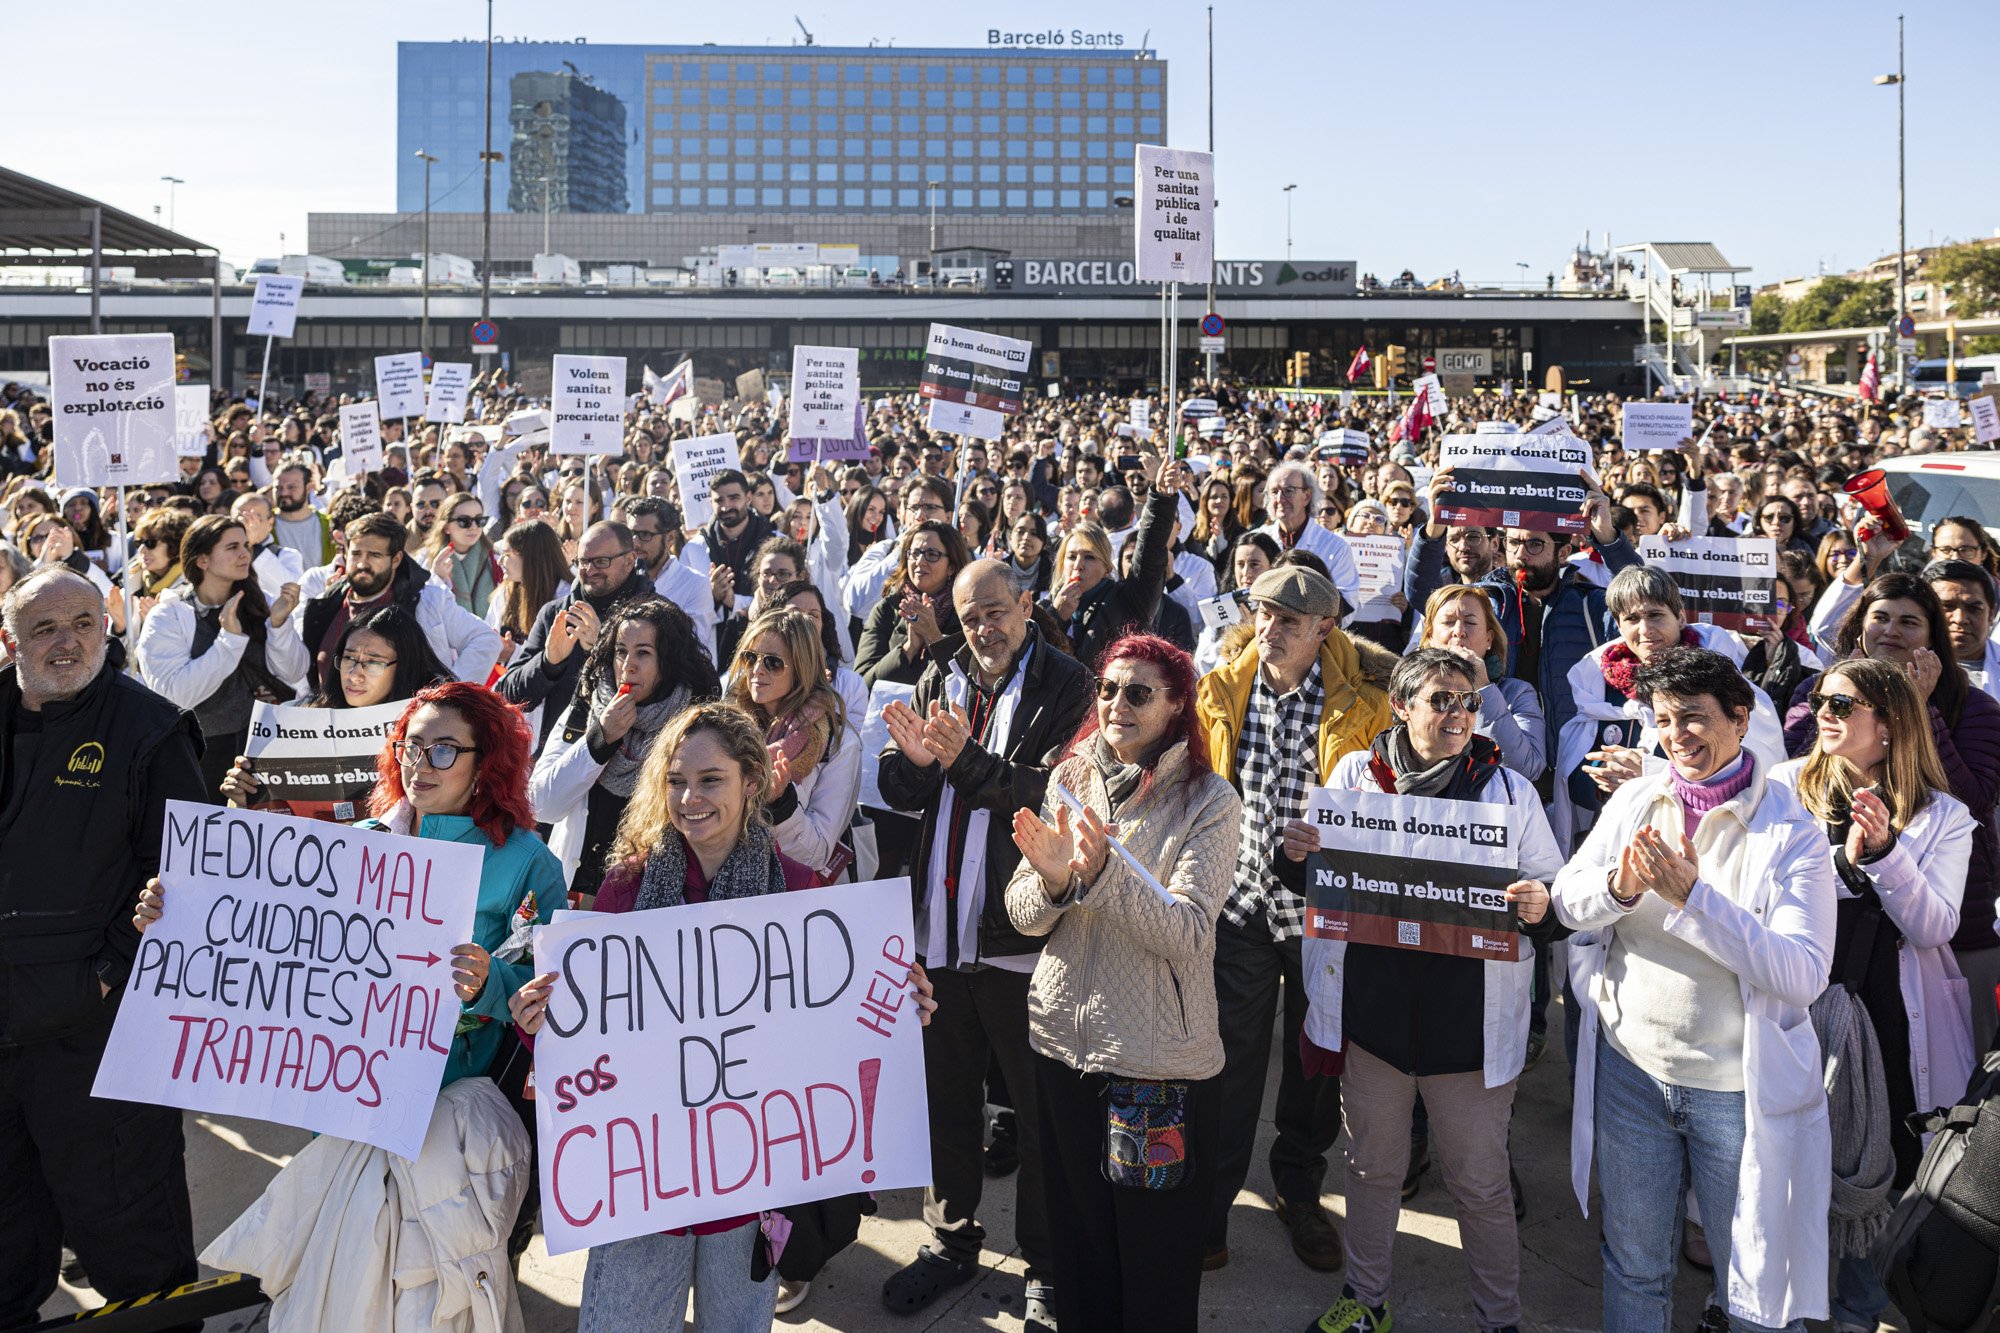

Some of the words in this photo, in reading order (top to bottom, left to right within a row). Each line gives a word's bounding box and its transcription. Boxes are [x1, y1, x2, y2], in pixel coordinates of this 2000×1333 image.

[988, 29, 1064, 45] Barceló
[1071, 29, 1124, 45] Sants
[1154, 166, 1174, 178] Per
[1177, 171, 1200, 181] una
[1157, 182, 1199, 196] sanitat
[1156, 196, 1200, 211] pública
[1166, 212, 1170, 224] i
[1174, 212, 1188, 225] de
[1154, 227, 1200, 242] qualitat
[1025, 261, 1138, 286] BARCELO
[1214, 262, 1264, 286] NTS
[1302, 266, 1349, 282] adif
[1737, 286, 1748, 301] P
[933, 334, 949, 345] Ho
[951, 337, 974, 350] hem
[976, 343, 1008, 358] donat
[1008, 350, 1025, 361] tot
[73, 356, 150, 372] Vocació
[806, 358, 823, 368] Per
[825, 361, 845, 369] una
[1444, 354, 1484, 369] COMO
[569, 368, 610, 380] Volem
[806, 369, 843, 379] sanitat
[927, 363, 945, 375] No
[946, 366, 970, 380] hem
[972, 372, 1002, 387] rebut
[1002, 379, 1019, 391] res
[85, 382, 109, 393] no
[114, 377, 135, 391] és
[566, 384, 612, 395] sanitat
[576, 398, 581, 408] i
[584, 401, 601, 409] no
[813, 391, 817, 399] i
[819, 391, 832, 400] de
[63, 396, 165, 417] explotació
[803, 401, 844, 412] qualitat
[556, 412, 620, 423] precarietat
[686, 449, 703, 459] Per
[706, 446, 725, 456] una
[1447, 446, 1468, 456] Ho
[1473, 445, 1507, 456] hem
[1510, 446, 1557, 459] donat
[1560, 449, 1585, 463] tot
[690, 456, 726, 469] sanitat
[1470, 481, 1506, 495] hem
[1509, 483, 1555, 498] rebut
[1557, 488, 1585, 500] res
[1376, 543, 1401, 551] LABORAL
[1646, 548, 1666, 559] Ho
[1669, 547, 1699, 560] hem
[1702, 550, 1745, 563] donat
[1747, 553, 1768, 565] tot
[1678, 587, 1700, 598] em
[1702, 587, 1744, 601] rebut
[1746, 591, 1769, 602] res
[1217, 605, 1229, 620] Ho
[252, 721, 271, 738] Ho
[276, 724, 318, 739] hem
[323, 725, 382, 739] donat
[252, 771, 282, 785] No
[285, 771, 330, 785] hem
[334, 768, 380, 783] rebu
[1317, 808, 1346, 826] Ho
[1351, 811, 1397, 832] hem
[1402, 816, 1467, 840] donat
[1472, 825, 1505, 844] tot
[165, 810, 346, 898] MÉDICOS
[356, 845, 444, 925] MAL
[1315, 868, 1347, 889] No
[1352, 871, 1399, 895] hem
[1404, 881, 1466, 904] rebut
[1470, 890, 1506, 909] res
[205, 894, 395, 978] CUIDADOS
[1325, 924, 1348, 932] Catalunya
[1484, 944, 1509, 952] Catalunya
[545, 908, 855, 1038] SANIDAD
[856, 934, 913, 1038] HELP
[134, 938, 357, 1026] PACIENTES
[361, 981, 449, 1055] MAL
[169, 1014, 389, 1108] TRATADOS
[679, 1024, 758, 1108] DE
[555, 1053, 618, 1113] SOS
[552, 1057, 882, 1227] CALIDAD!
